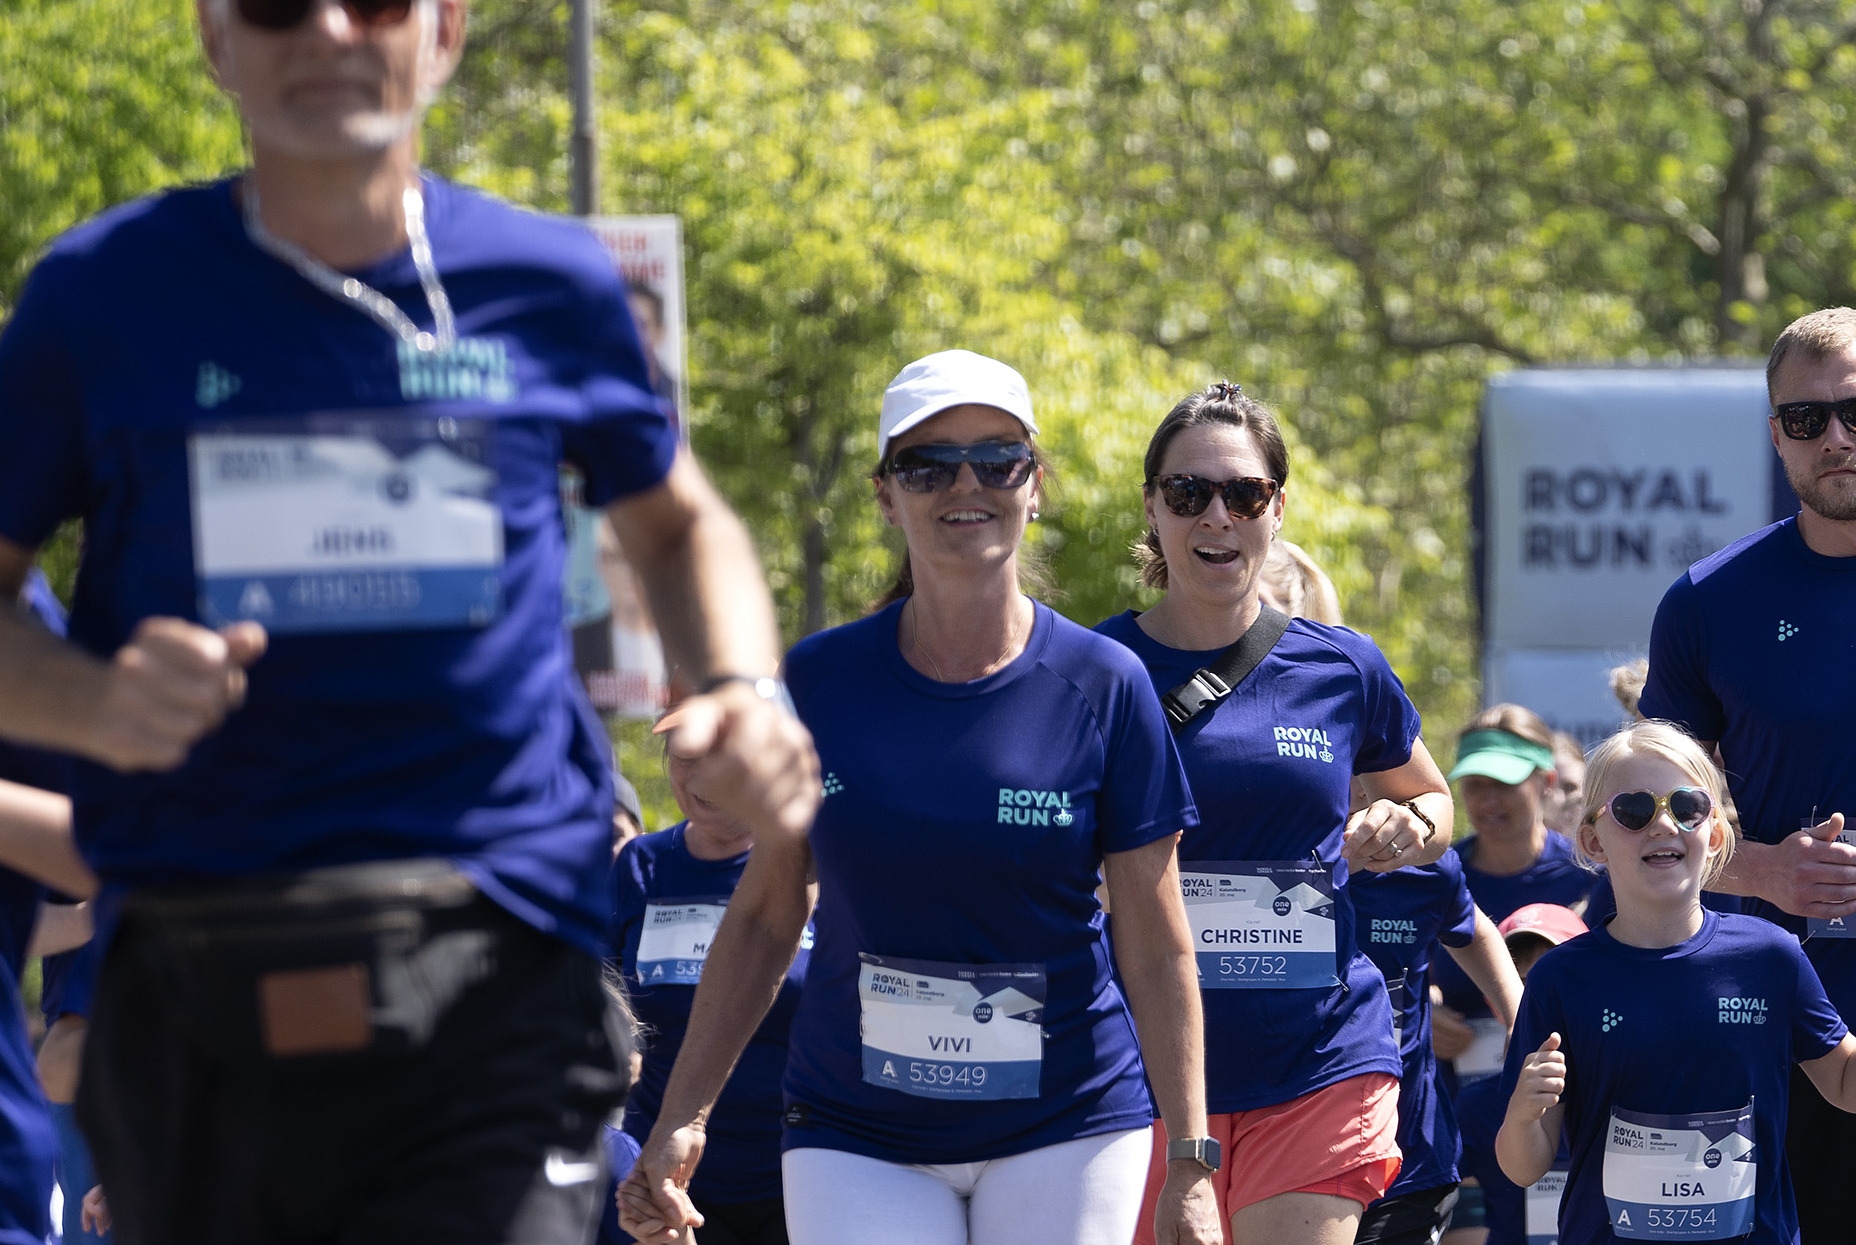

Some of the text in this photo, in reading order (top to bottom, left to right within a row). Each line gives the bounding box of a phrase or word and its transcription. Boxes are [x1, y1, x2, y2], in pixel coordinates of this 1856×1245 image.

[1523, 465, 1726, 515] ROYAL
[1523, 524, 1652, 567] RUN
[1273, 726, 1332, 746] ROYAL
[1277, 742, 1317, 760] RUN
[998, 788, 1071, 808] ROYAL
[997, 806, 1049, 826] RUN
[1274, 900, 1290, 908] one
[1371, 918, 1418, 931] ROYAL
[1201, 929, 1303, 944] CHRISTINE
[1371, 931, 1402, 943] RUN
[652, 963, 664, 976] A
[1219, 956, 1287, 975] 53752
[872, 973, 910, 988] ROYAL
[975, 1007, 992, 1015] one
[1718, 998, 1768, 1011] ROYAL
[1718, 1011, 1751, 1024] RUN
[928, 1036, 972, 1052] VIVI
[882, 1060, 897, 1077] A
[909, 1062, 987, 1086] 53949
[1614, 1125, 1644, 1140] ROYAL
[1705, 1152, 1720, 1160] one
[1661, 1183, 1705, 1197] LISA
[1617, 1209, 1632, 1226] A
[1647, 1208, 1717, 1227] 53754
